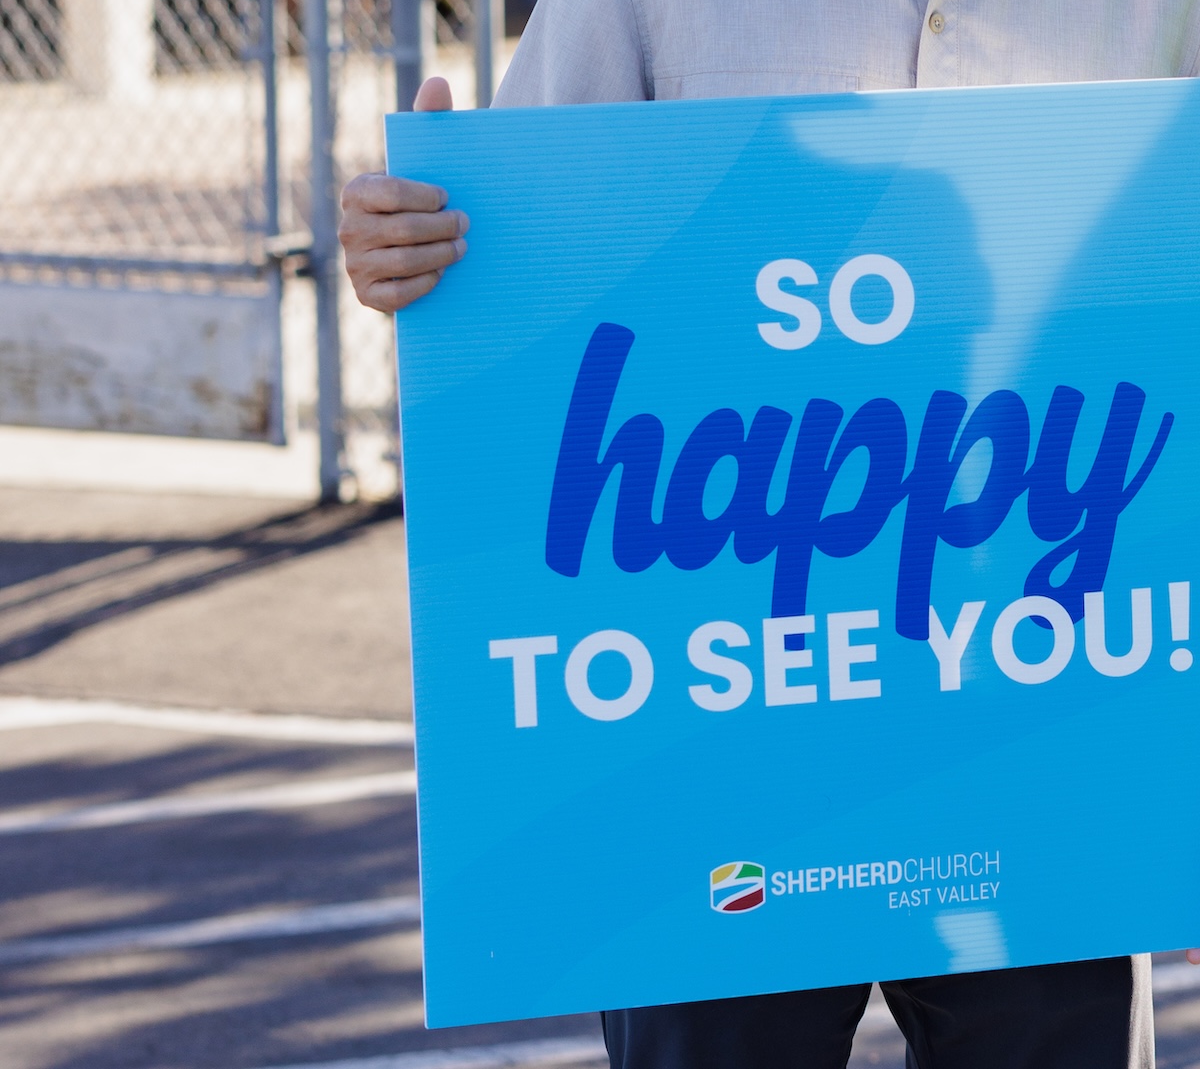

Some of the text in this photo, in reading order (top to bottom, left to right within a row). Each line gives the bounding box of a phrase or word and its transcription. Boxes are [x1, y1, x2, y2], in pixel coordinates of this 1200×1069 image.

[754, 253, 916, 351] SO
[545, 321, 1175, 641] happy
[488, 580, 1195, 728] TO SEE YOU!
[770, 850, 1000, 896] SHEPHERDCHURCH
[888, 881, 1001, 910] EAST VALLEY
